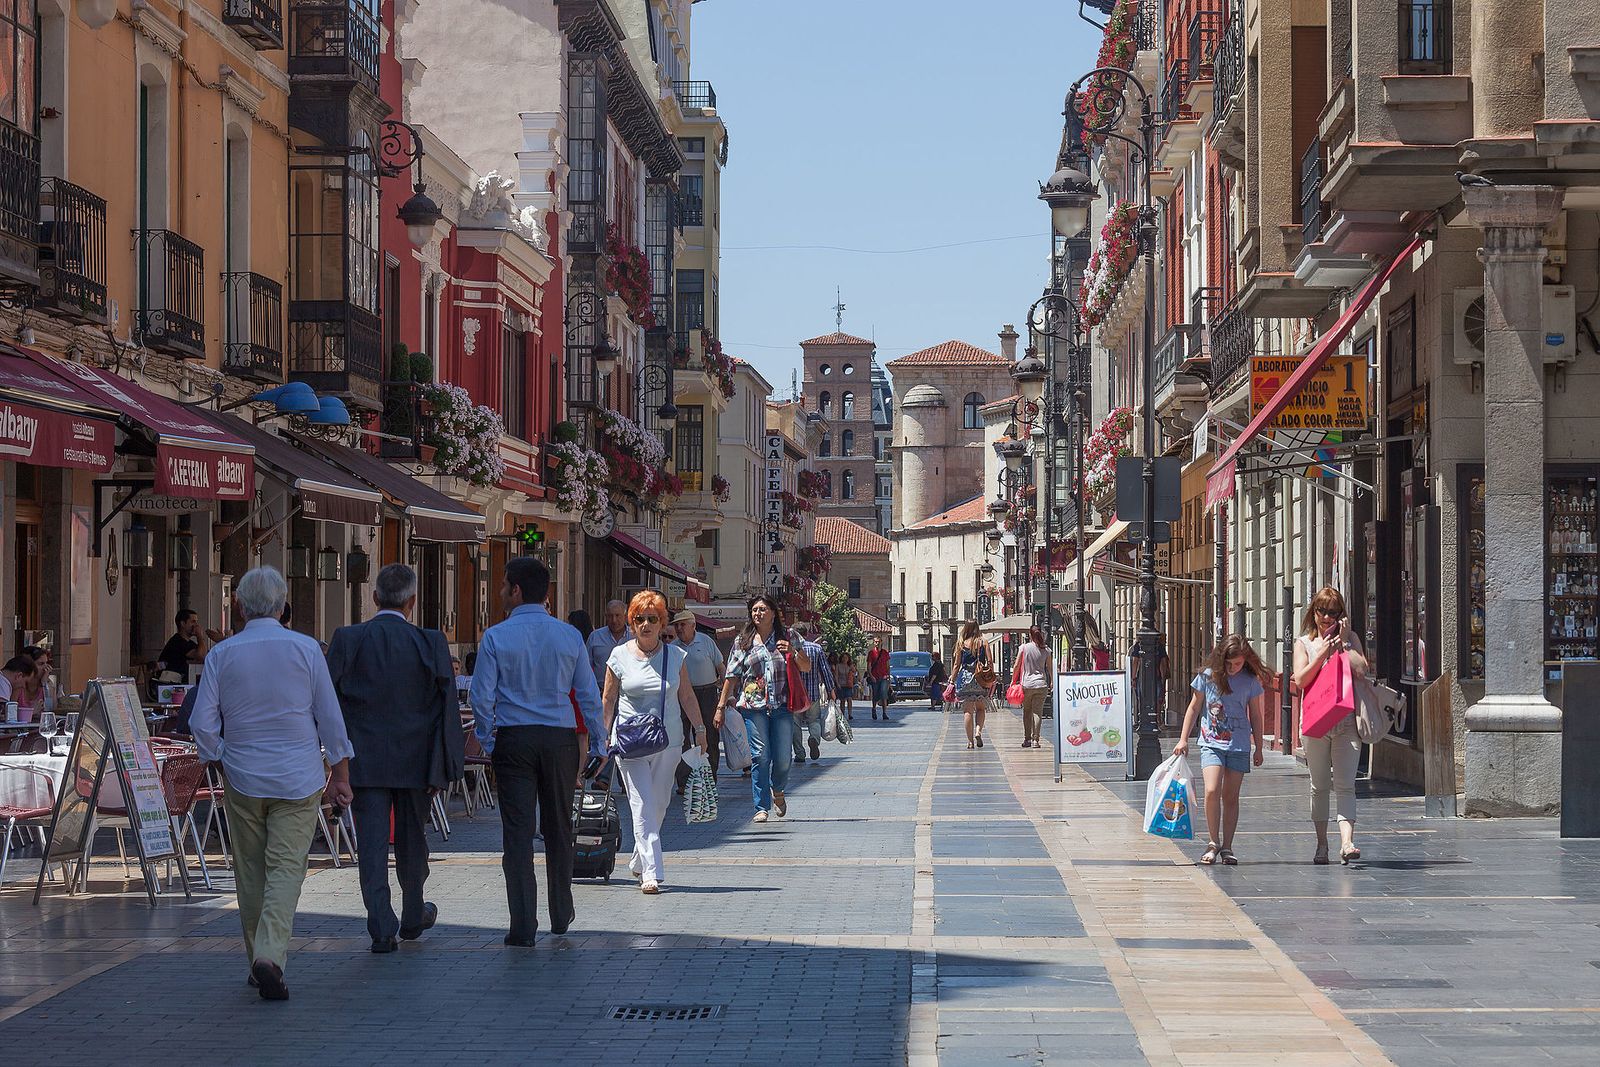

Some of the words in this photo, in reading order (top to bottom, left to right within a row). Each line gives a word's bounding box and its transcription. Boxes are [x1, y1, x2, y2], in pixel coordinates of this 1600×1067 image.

[1343, 361, 1356, 392] 1
[1304, 413, 1333, 426] COLOR
[168, 456, 210, 488] CAFETERIA
[217, 455, 246, 494] albany
[130, 495, 198, 510] vinoteca
[1065, 681, 1119, 702] SMOOTHIE
